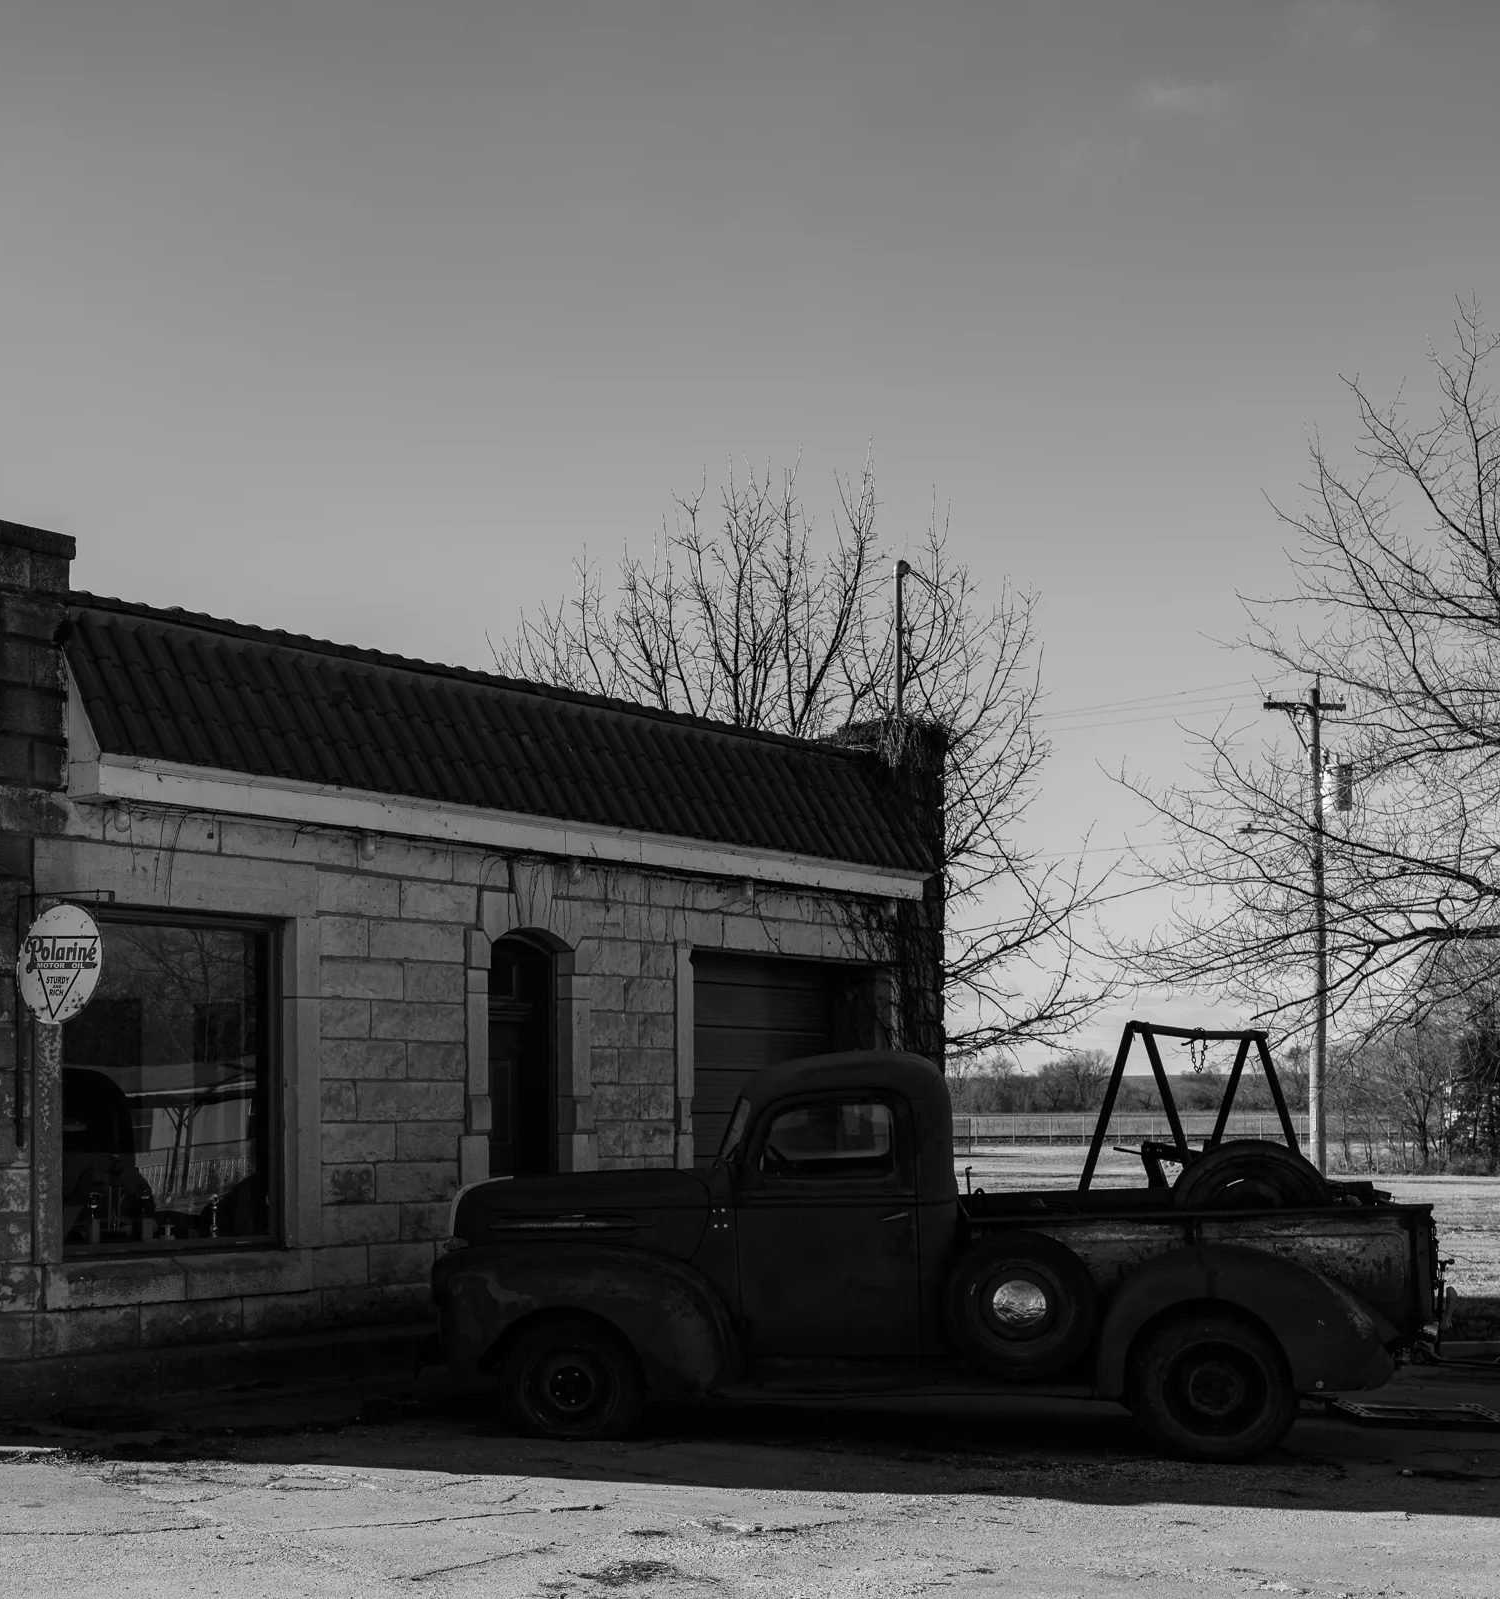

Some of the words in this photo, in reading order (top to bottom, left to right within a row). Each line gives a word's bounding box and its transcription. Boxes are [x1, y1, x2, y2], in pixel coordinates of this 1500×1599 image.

[25, 935, 97, 963] Polarine
[46, 976, 70, 984] STURDY
[49, 989, 64, 997] RICH
